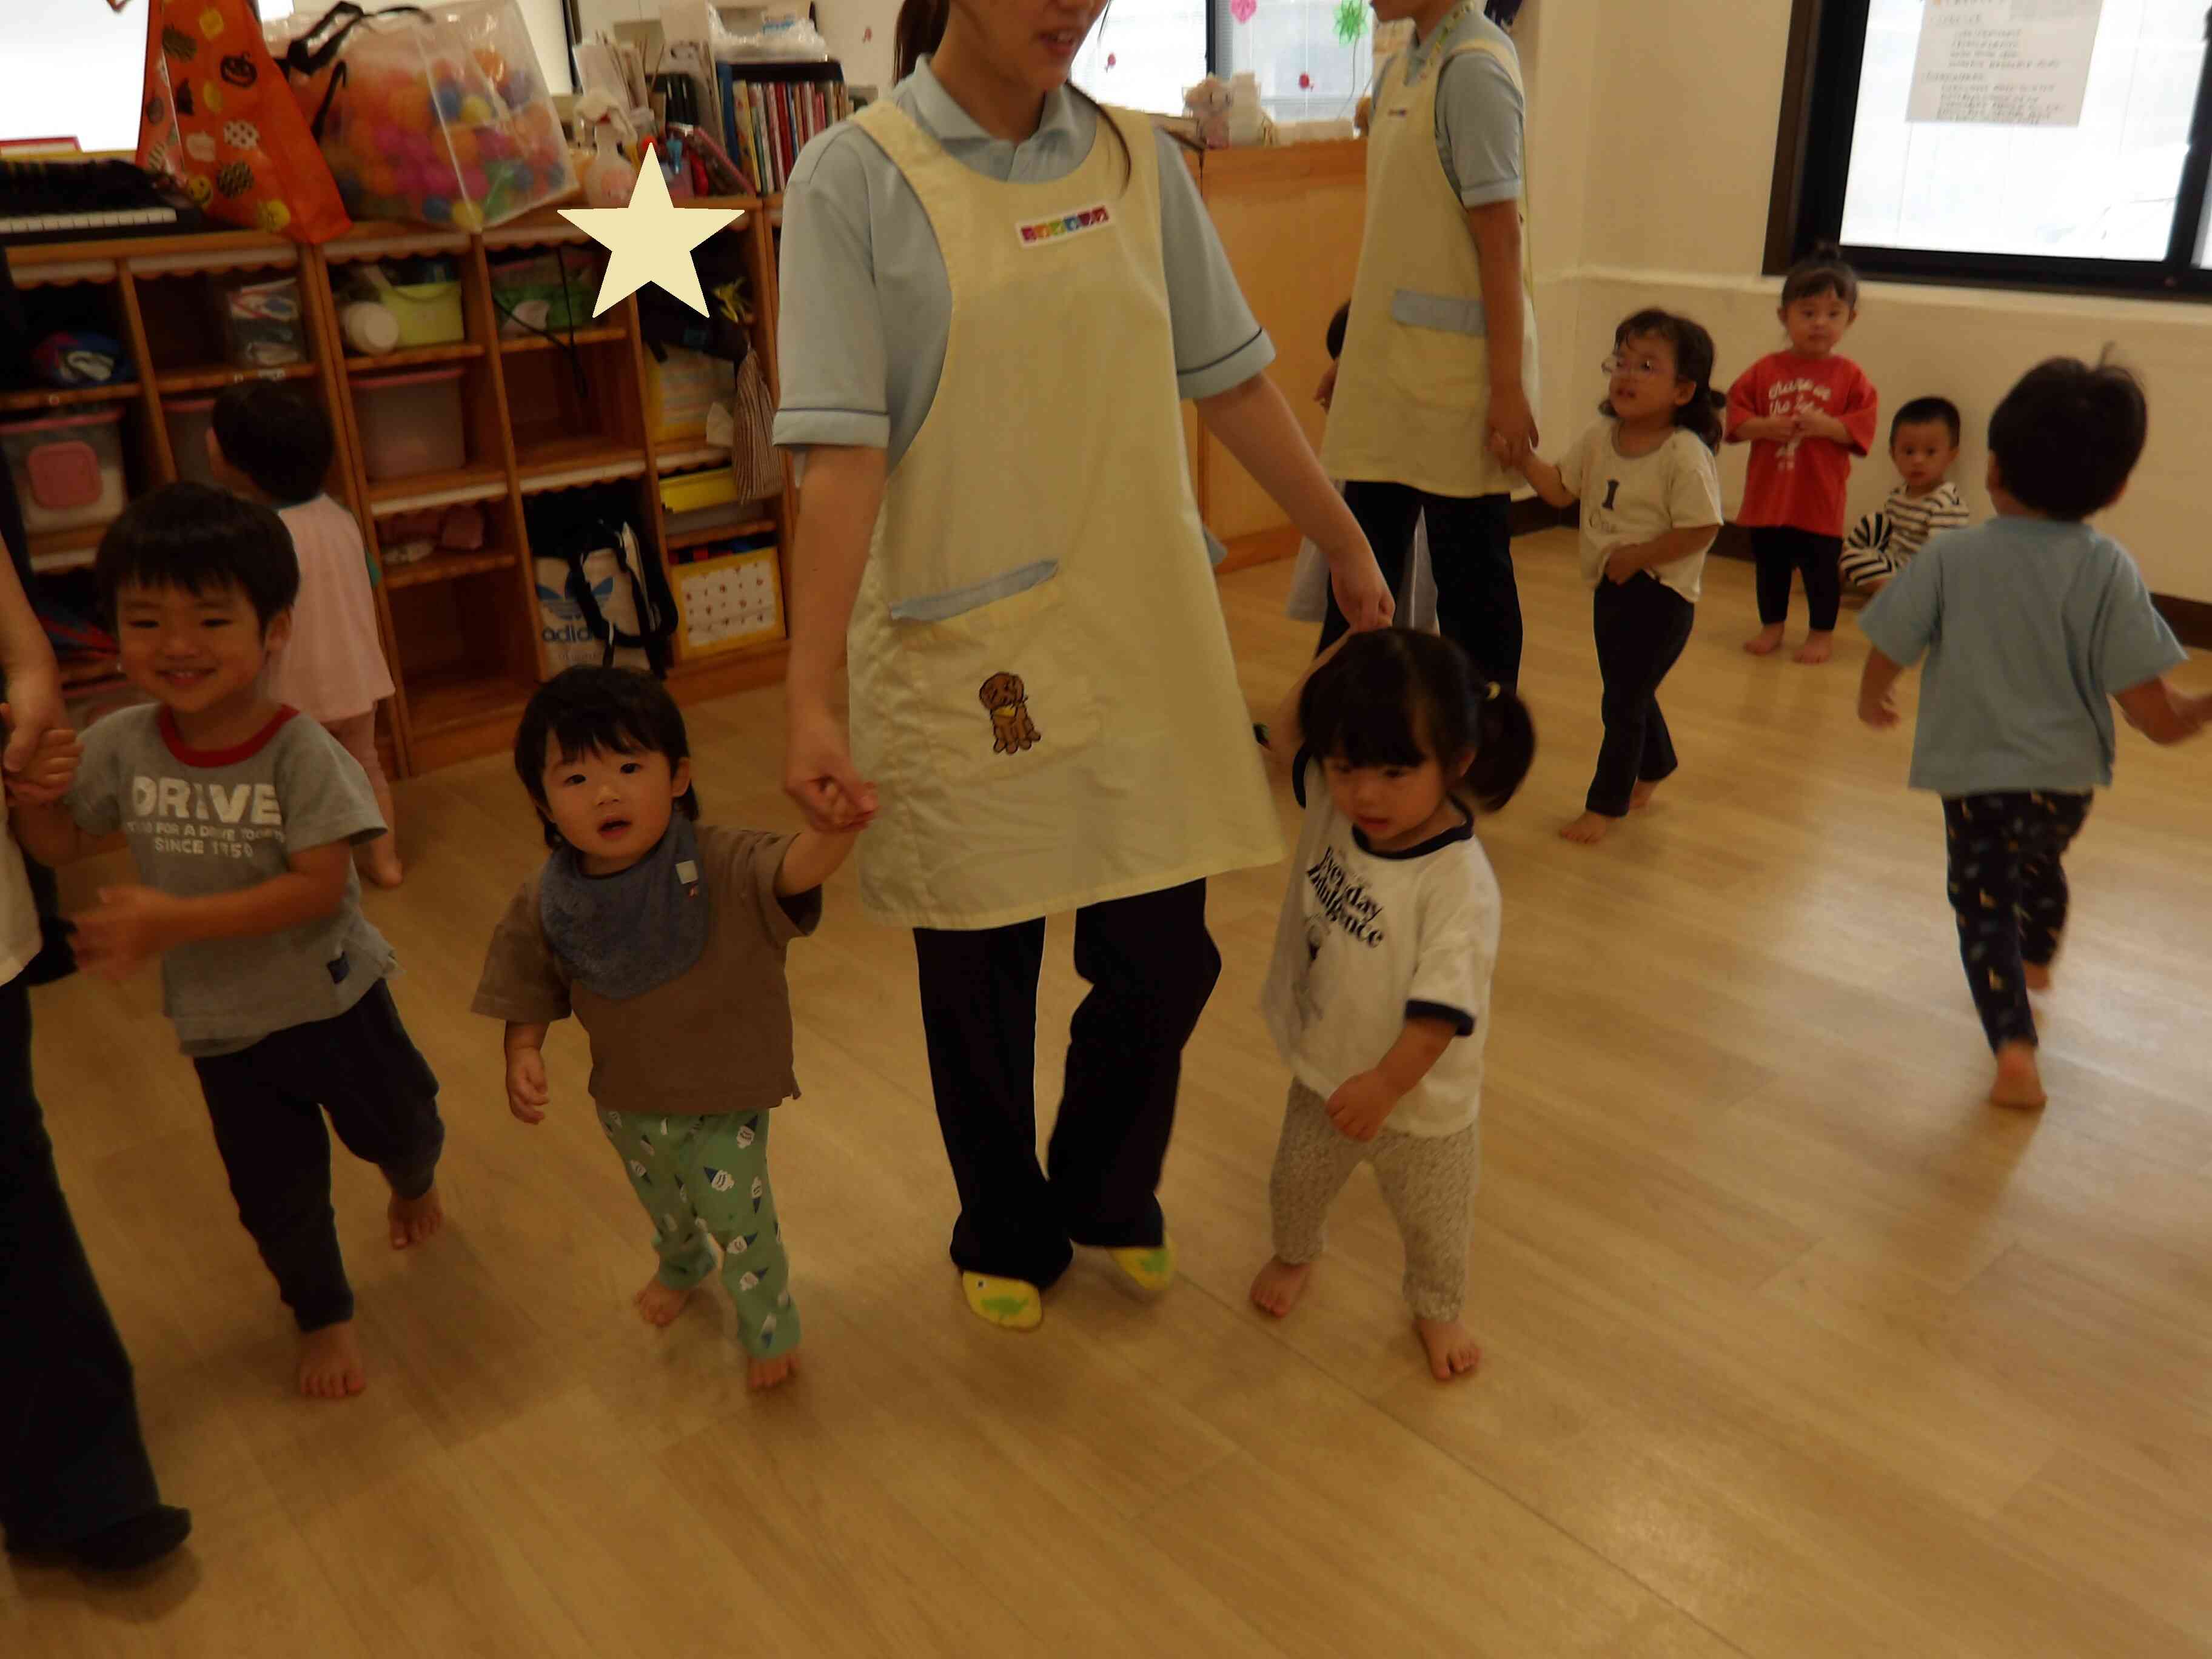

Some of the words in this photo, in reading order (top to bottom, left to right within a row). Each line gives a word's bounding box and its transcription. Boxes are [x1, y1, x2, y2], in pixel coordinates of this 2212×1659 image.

[543, 624, 592, 642] adid
[132, 775, 283, 825] DRIVE
[184, 823, 196, 836] A
[199, 825, 235, 842] DVE
[153, 836, 204, 854] SINCE
